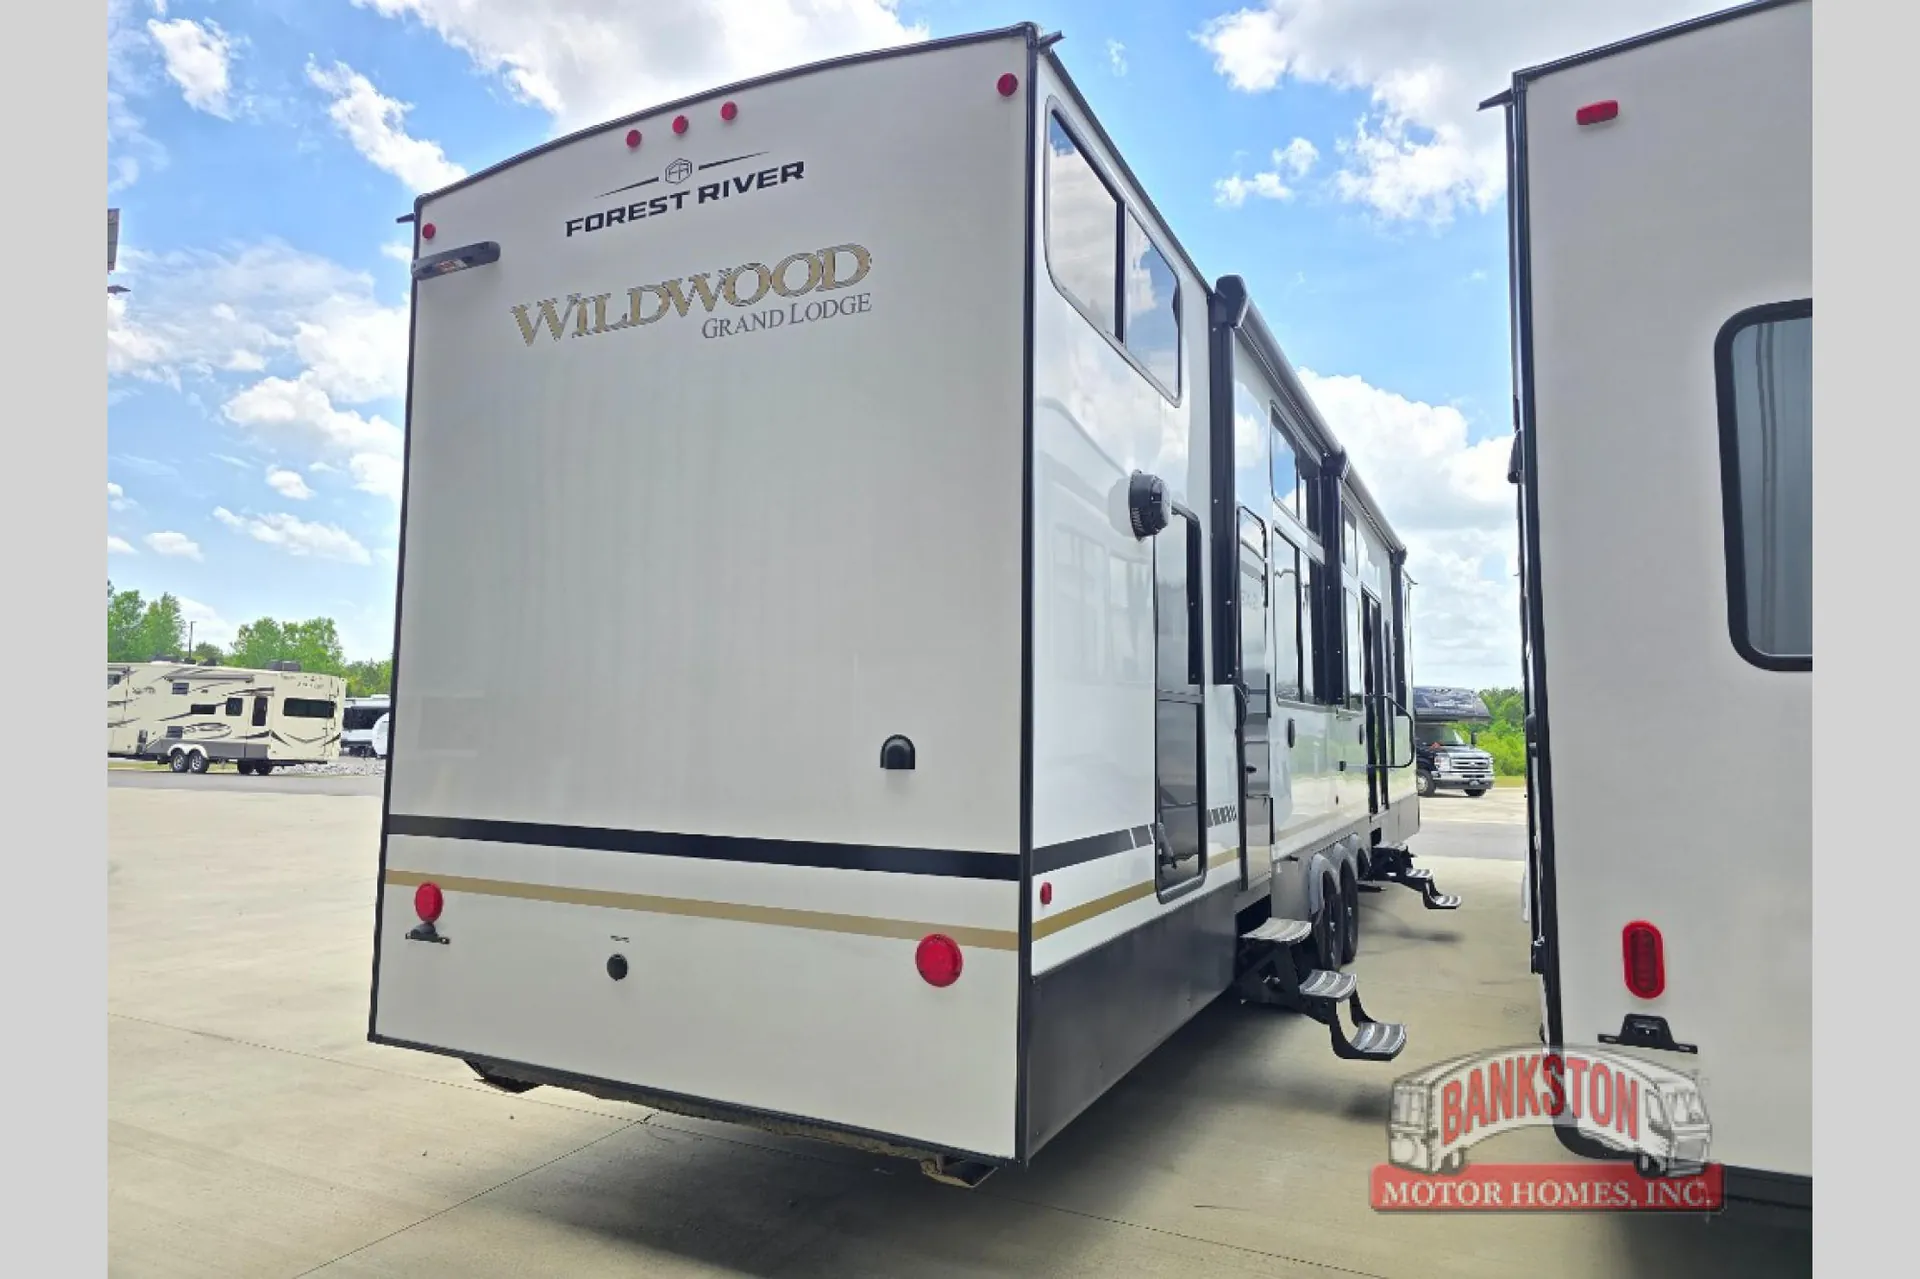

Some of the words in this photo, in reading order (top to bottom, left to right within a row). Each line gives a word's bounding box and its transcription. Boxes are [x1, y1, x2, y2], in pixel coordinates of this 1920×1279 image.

[566, 190, 691, 238] FOREST
[698, 161, 804, 204] RIVER
[511, 242, 872, 347] WILDWOOD
[702, 308, 785, 340] GRAND
[788, 292, 872, 325] LODGE
